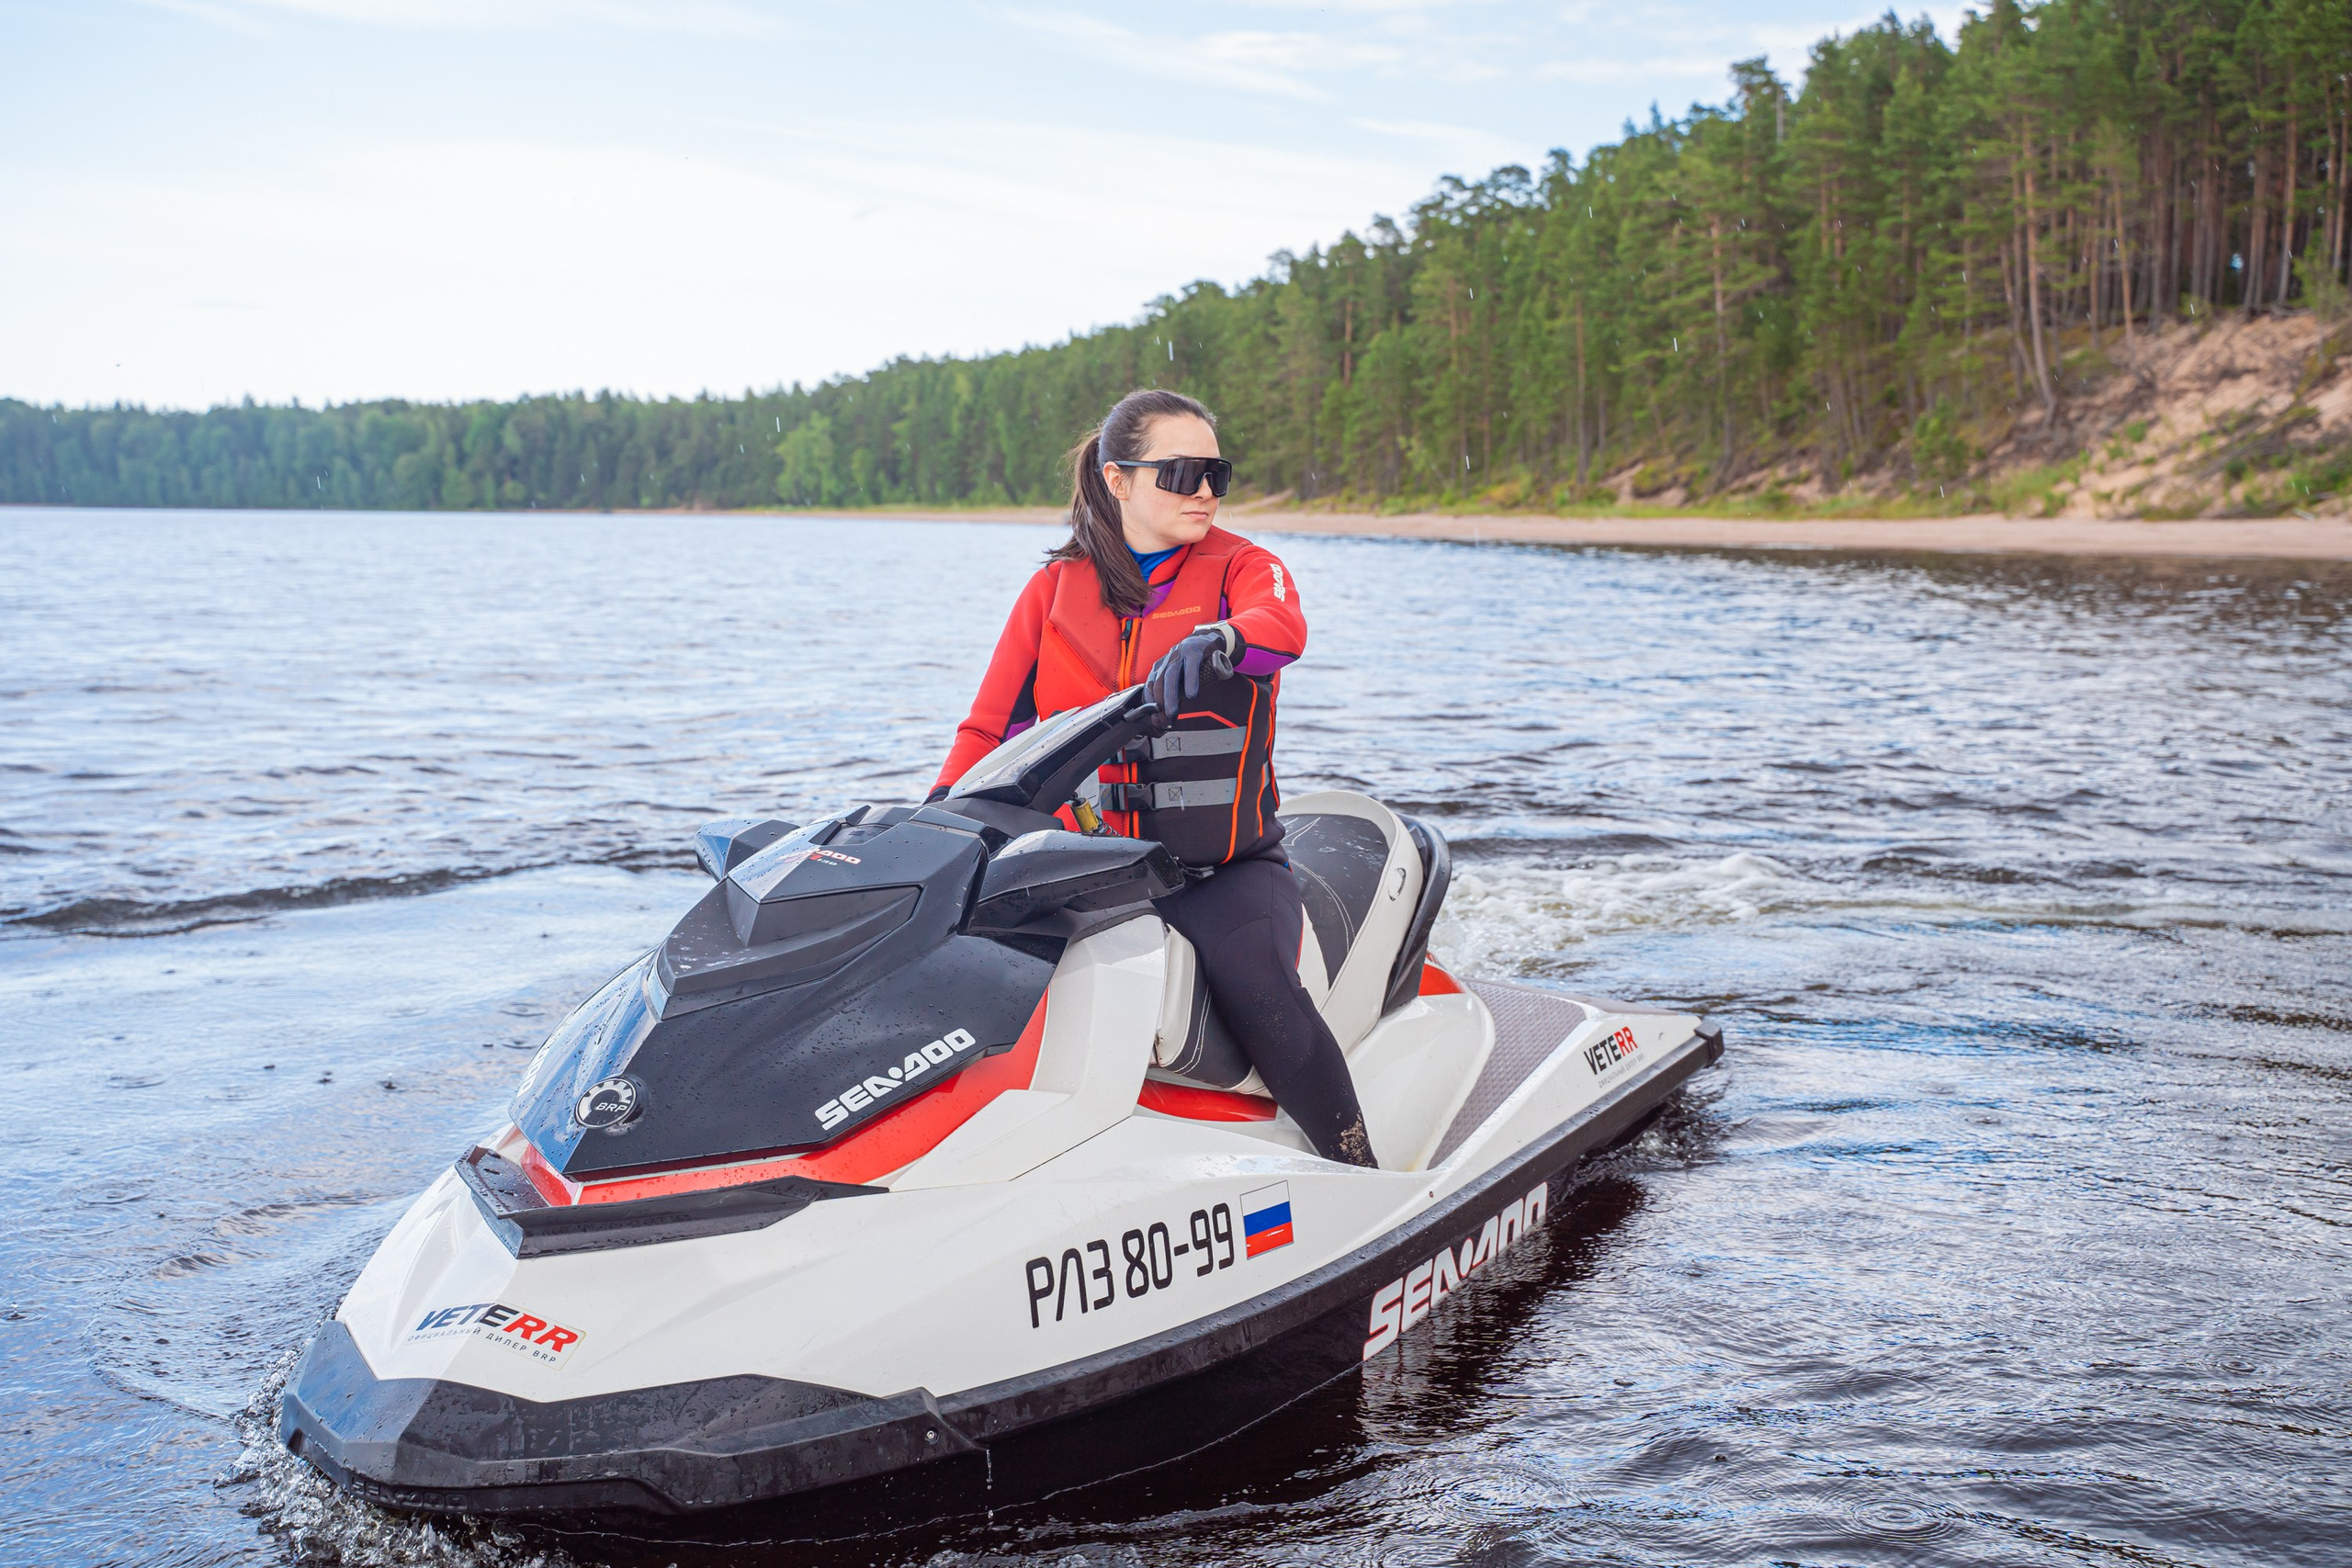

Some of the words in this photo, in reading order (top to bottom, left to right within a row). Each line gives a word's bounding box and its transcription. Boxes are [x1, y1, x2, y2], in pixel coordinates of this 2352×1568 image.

[1583, 1026, 1638, 1076] VETERR
[595, 1102, 628, 1112] BRP
[1122, 1202, 1235, 1298] 80-99
[416, 1303, 578, 1352] VETERR
[486, 1334, 527, 1352] ДИЛЕР
[533, 1350, 557, 1363] BRP
